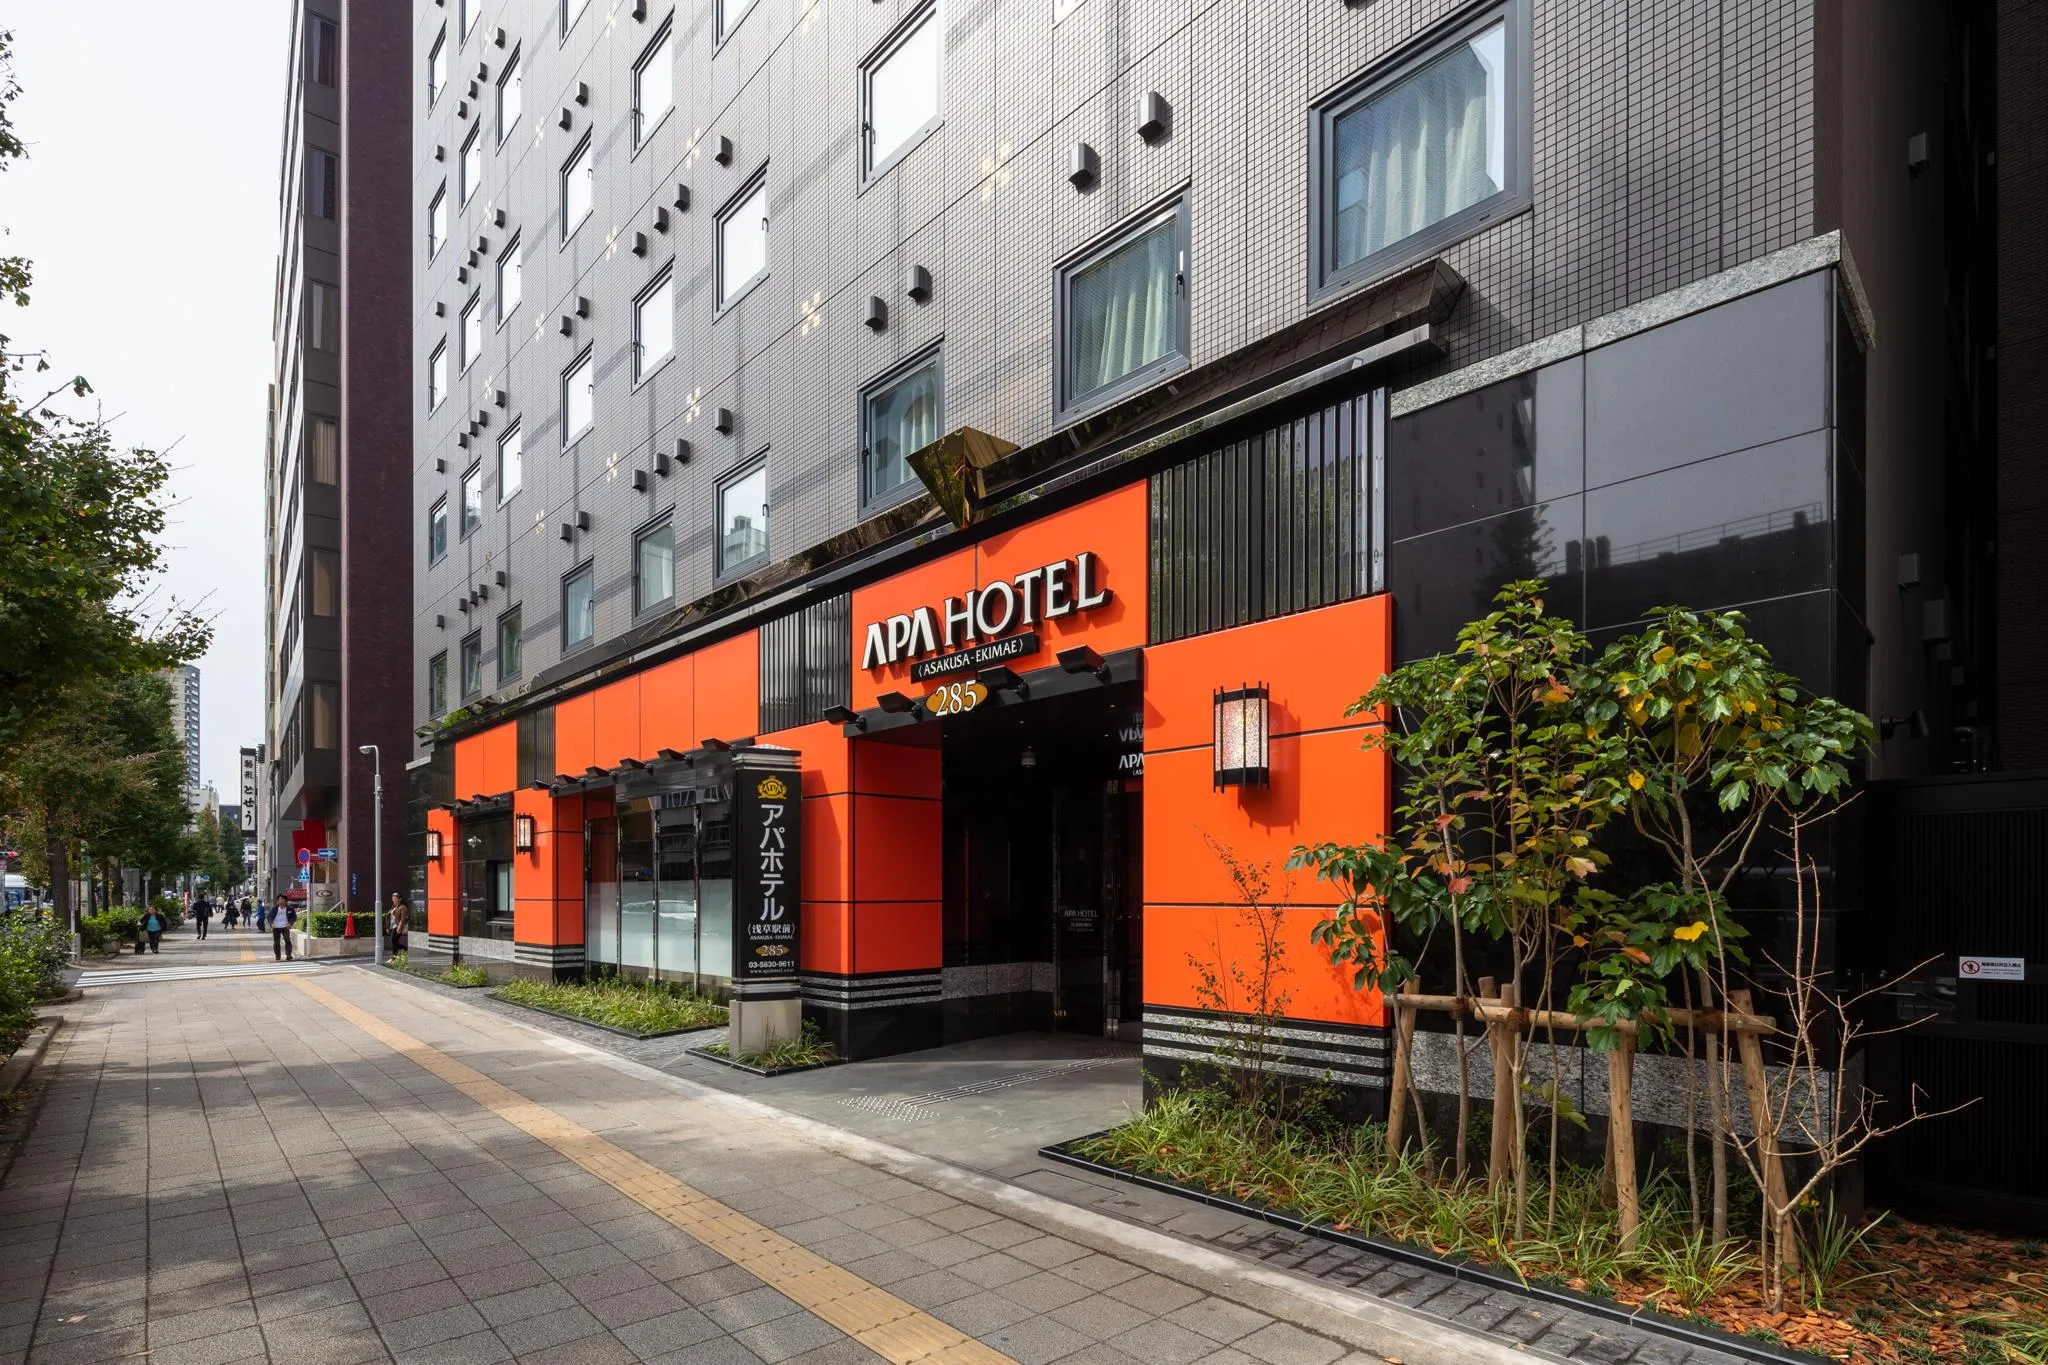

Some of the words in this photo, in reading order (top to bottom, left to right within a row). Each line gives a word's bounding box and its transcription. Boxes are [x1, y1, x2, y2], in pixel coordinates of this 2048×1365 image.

[861, 606, 938, 670] APA
[944, 551, 1109, 647] HOTEL
[935, 679, 977, 717] 285
[760, 803, 785, 921] アパホテル
[748, 960, 795, 969] 03-5830-9611
[761, 944, 784, 957] 285
